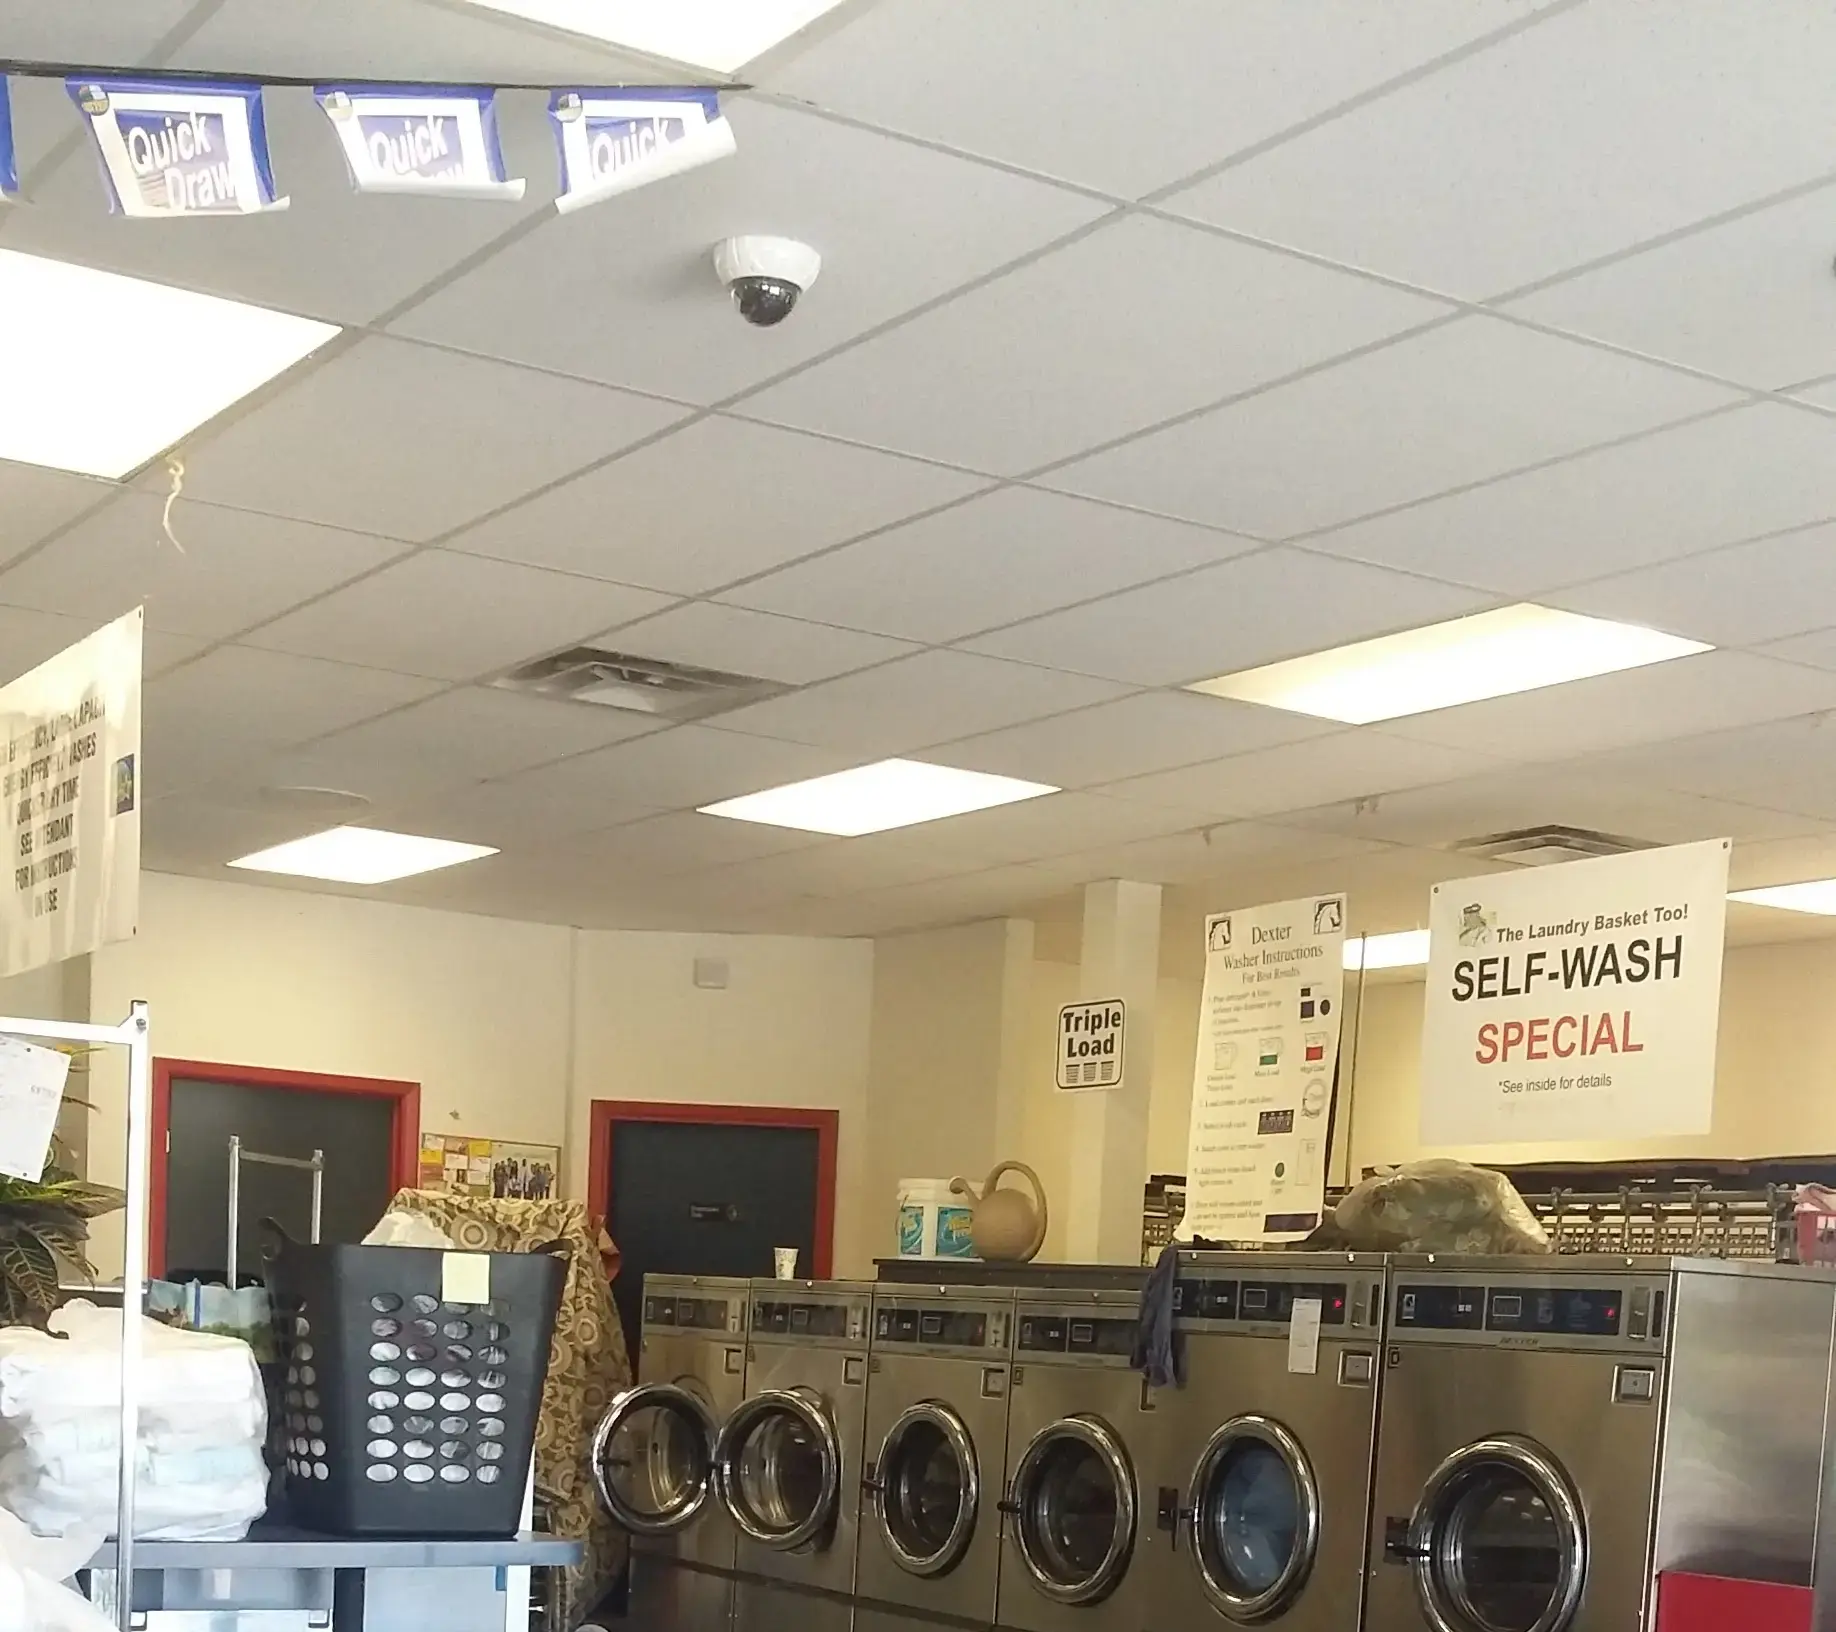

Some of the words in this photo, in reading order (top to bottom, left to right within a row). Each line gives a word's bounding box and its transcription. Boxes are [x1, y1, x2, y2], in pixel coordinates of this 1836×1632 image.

[127, 109, 211, 174] Quick
[369, 114, 448, 175] Quick
[592, 117, 672, 180] Quick
[163, 160, 236, 211] Draw
[20, 829, 32, 857] SEE
[34, 812, 73, 848] TENDANT
[30, 846, 78, 887] INUCTIONS
[1251, 925, 1292, 945] Dexter
[1496, 926, 1524, 943] The
[1528, 917, 1590, 940] Laundry
[1594, 909, 1649, 930] Basket
[1653, 903, 1690, 922] Too!
[1223, 952, 1260, 970] Washer
[1262, 944, 1324, 965] Instructions
[1242, 971, 1256, 984] For
[1257, 969, 1273, 982] Best
[1274, 966, 1301, 980] Results
[1451, 934, 1683, 1003] SELF-WASH
[1063, 1008, 1121, 1036] Triple
[1475, 1010, 1644, 1065] SPECIAL
[1066, 1032, 1115, 1059] Load
[1525, 1076, 1557, 1092] inside
[1559, 1075, 1575, 1089] for
[1576, 1073, 1612, 1088] details
